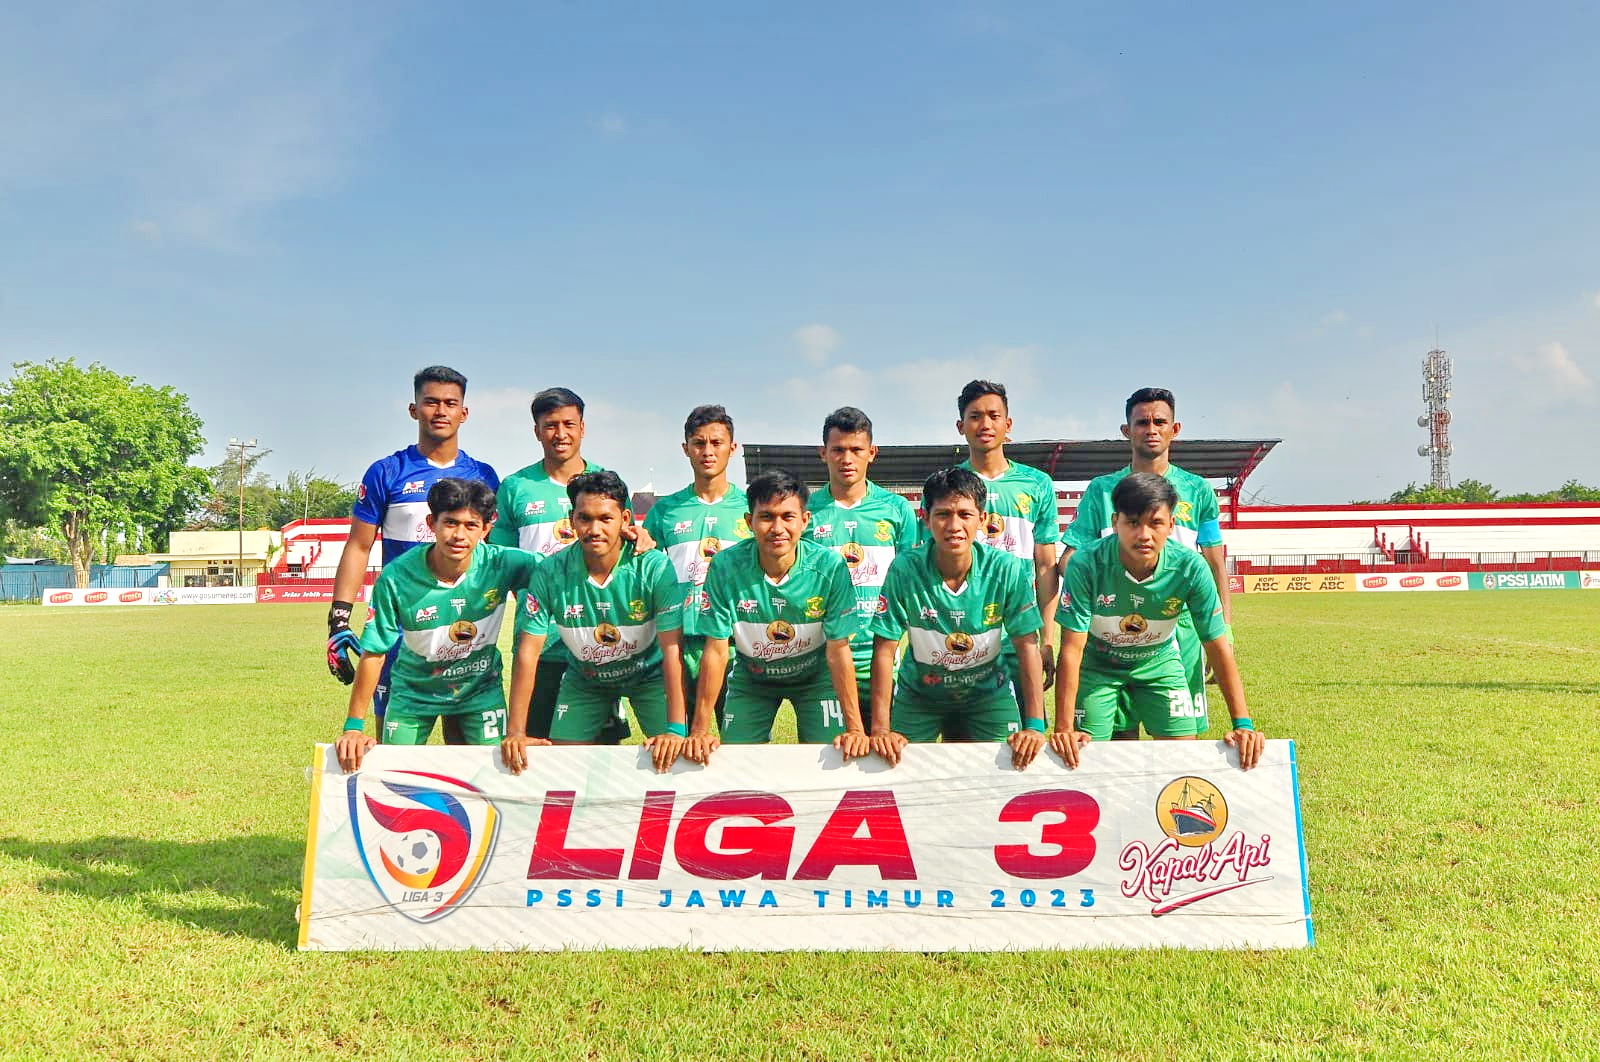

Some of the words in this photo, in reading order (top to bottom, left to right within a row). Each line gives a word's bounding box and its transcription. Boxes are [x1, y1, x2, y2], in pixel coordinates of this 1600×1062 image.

[1253, 582, 1279, 591] ABC
[1286, 582, 1312, 591] ABC
[1319, 581, 1345, 590] ABC
[1497, 573, 1528, 587] PSSI
[1529, 573, 1565, 587] JATIM
[820, 699, 844, 728] 14
[482, 709, 507, 738] 27
[527, 789, 918, 881] LIGA
[994, 788, 1101, 880] 3
[1118, 836, 1212, 903] Kapal
[1209, 830, 1271, 882] Api
[402, 891, 429, 903] LIGA
[433, 891, 444, 902] 3
[526, 889, 625, 908] PSSI
[658, 889, 779, 908] JAWA
[813, 889, 955, 908] TIMUR
[990, 889, 1096, 908] 2023
